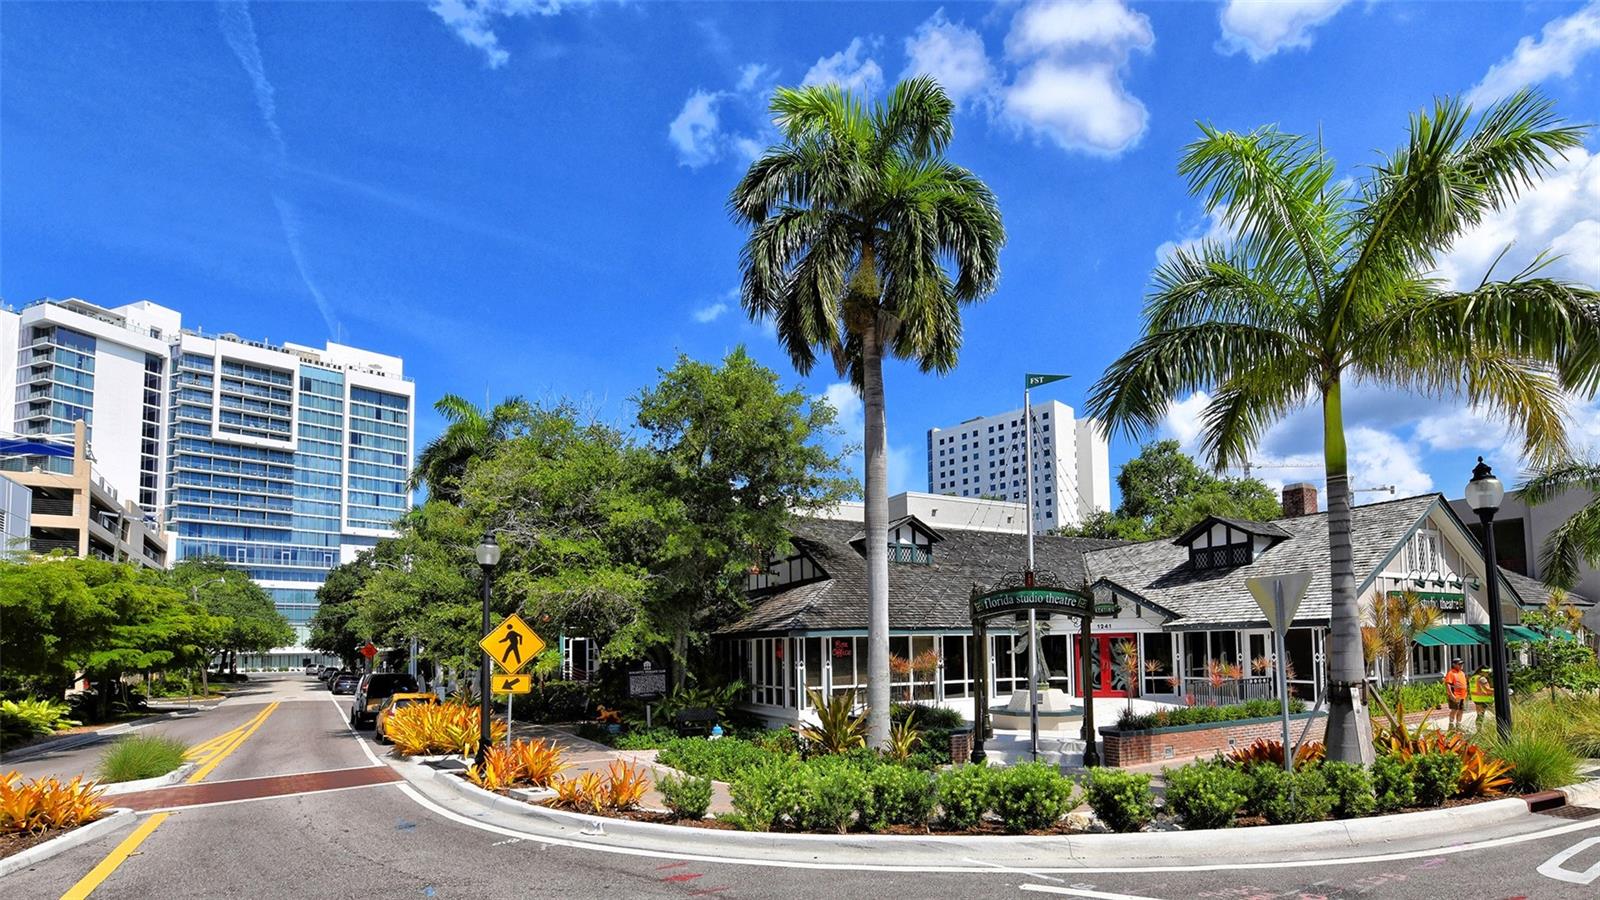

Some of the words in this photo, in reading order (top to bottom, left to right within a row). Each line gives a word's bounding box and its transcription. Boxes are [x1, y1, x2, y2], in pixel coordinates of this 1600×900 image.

[1030, 376, 1044, 384] FST
[984, 594, 1014, 609] florida
[1016, 592, 1044, 604] studio
[1046, 592, 1077, 607] theatre
